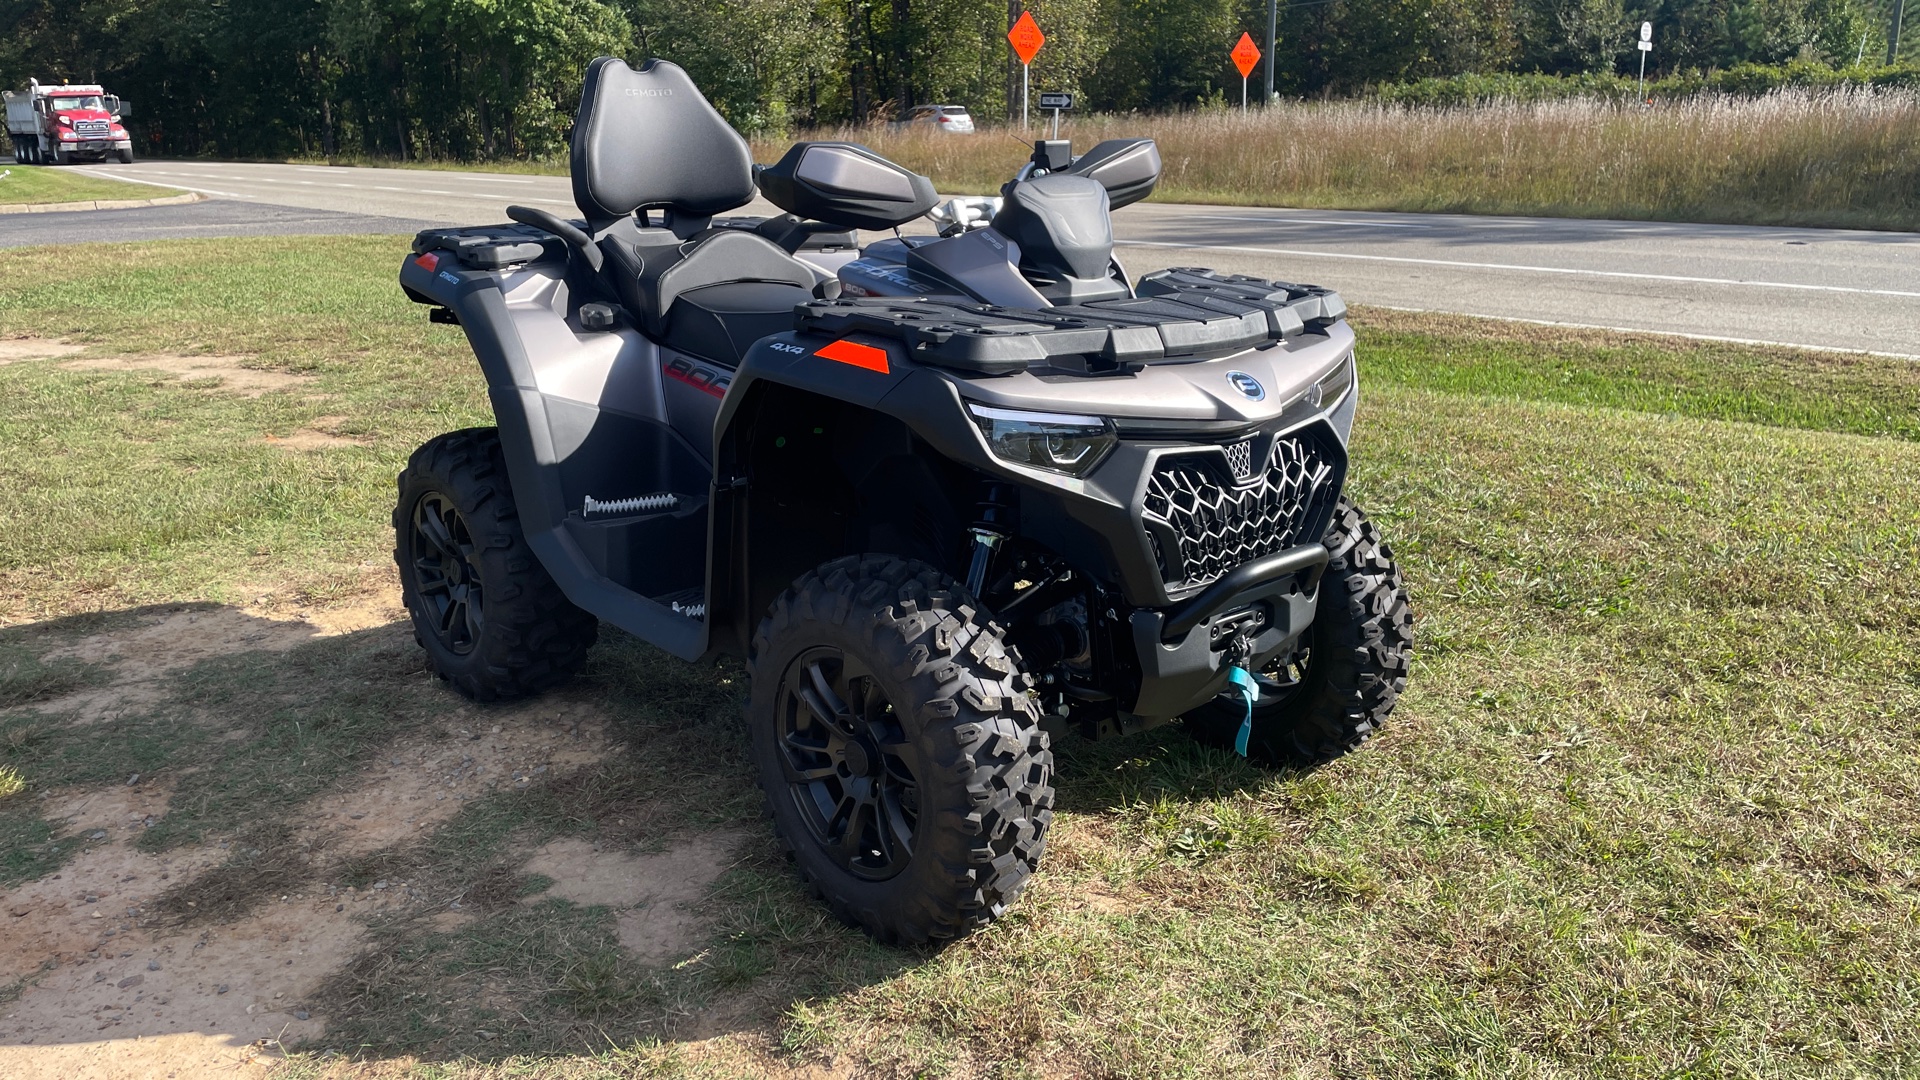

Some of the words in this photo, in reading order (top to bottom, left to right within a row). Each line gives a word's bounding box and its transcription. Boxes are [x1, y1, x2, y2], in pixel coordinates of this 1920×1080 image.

[1020, 25, 1034, 33] ROAD
[1018, 41, 1035, 49] AHEAD
[625, 88, 673, 97] CFMOTO
[981, 231, 1004, 249] EPS
[844, 283, 866, 296] 800
